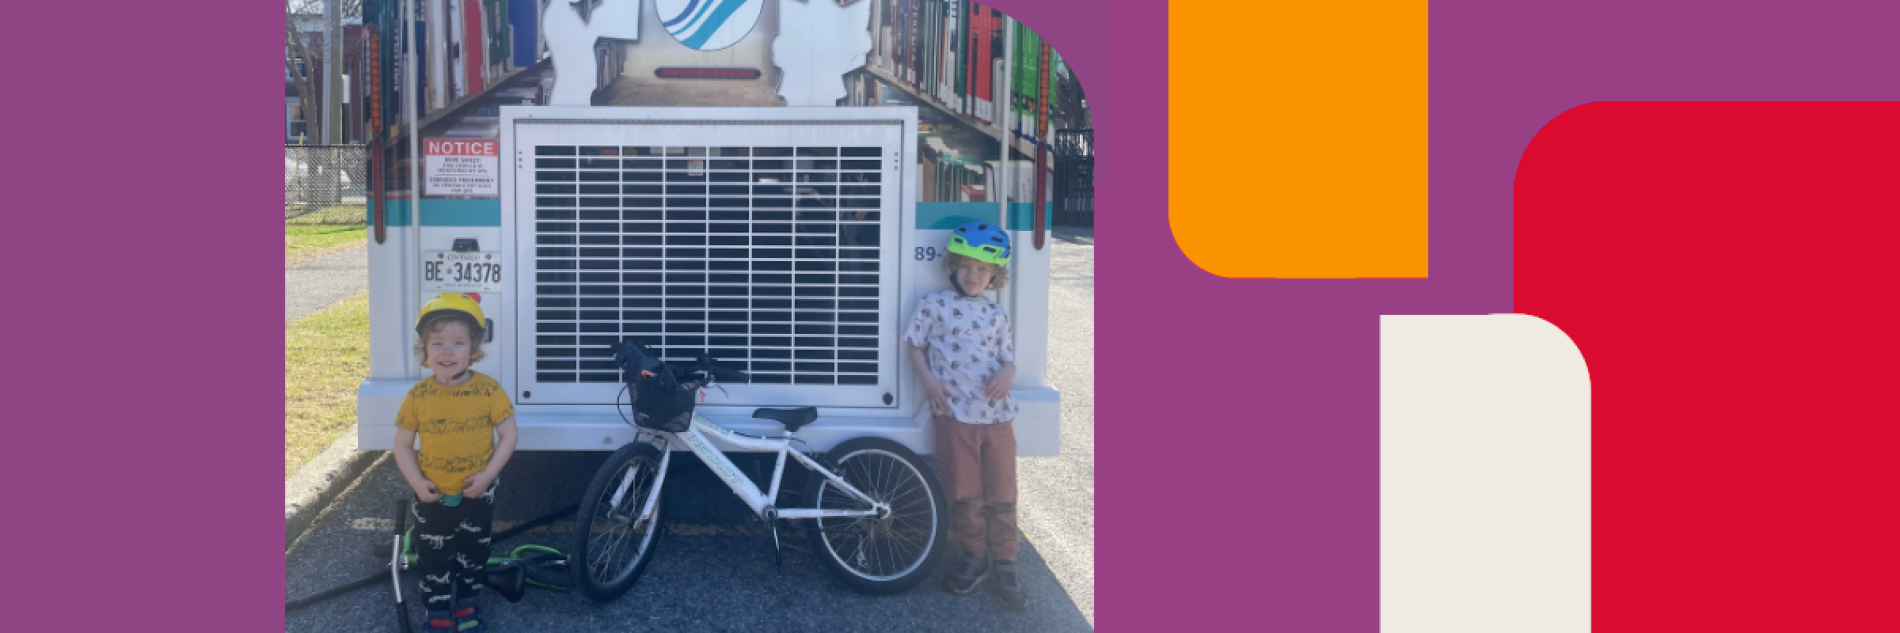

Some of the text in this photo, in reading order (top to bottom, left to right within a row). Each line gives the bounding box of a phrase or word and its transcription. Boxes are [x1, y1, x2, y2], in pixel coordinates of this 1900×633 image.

[428, 141, 494, 155] NOTICE
[914, 246, 948, 262] 89-
[425, 260, 501, 283] BE 34378
